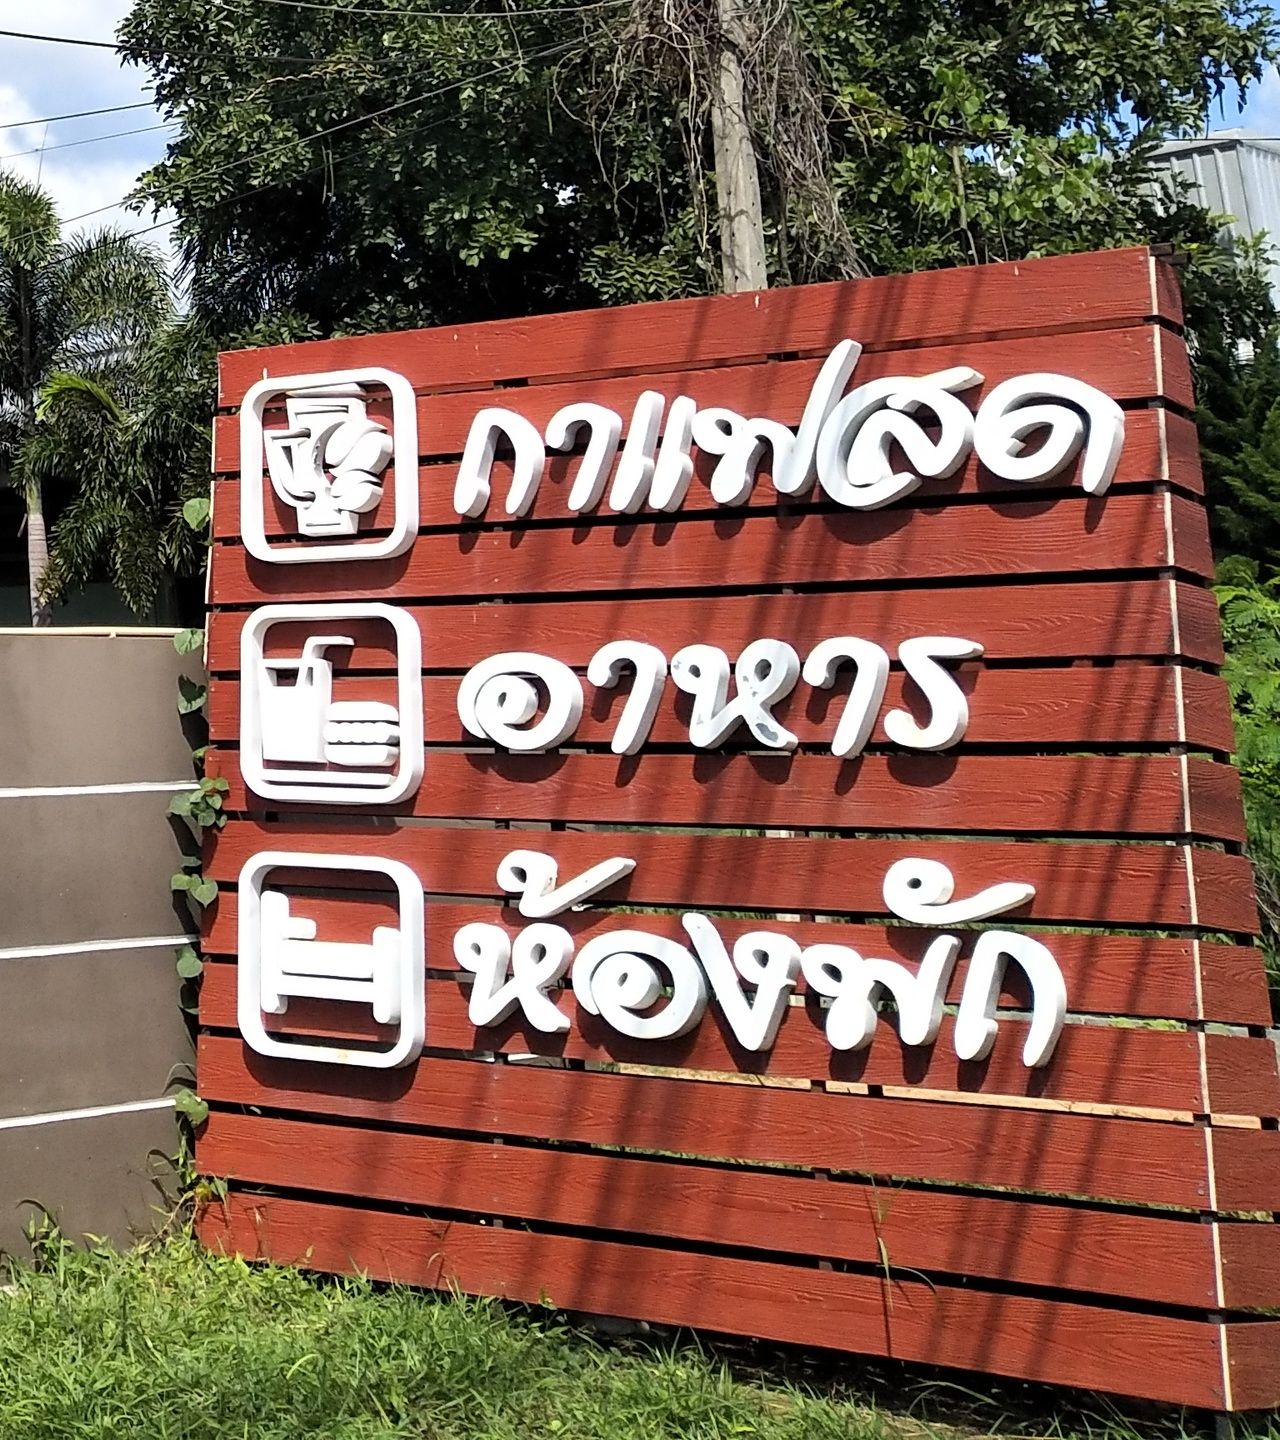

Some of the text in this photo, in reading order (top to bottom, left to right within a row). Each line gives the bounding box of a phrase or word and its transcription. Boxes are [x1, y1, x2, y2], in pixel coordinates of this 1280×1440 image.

[453, 338, 1126, 519] กาแฟสด
[457, 634, 985, 758] อาหาร
[452, 848, 1068, 1069] ห้องพัก
